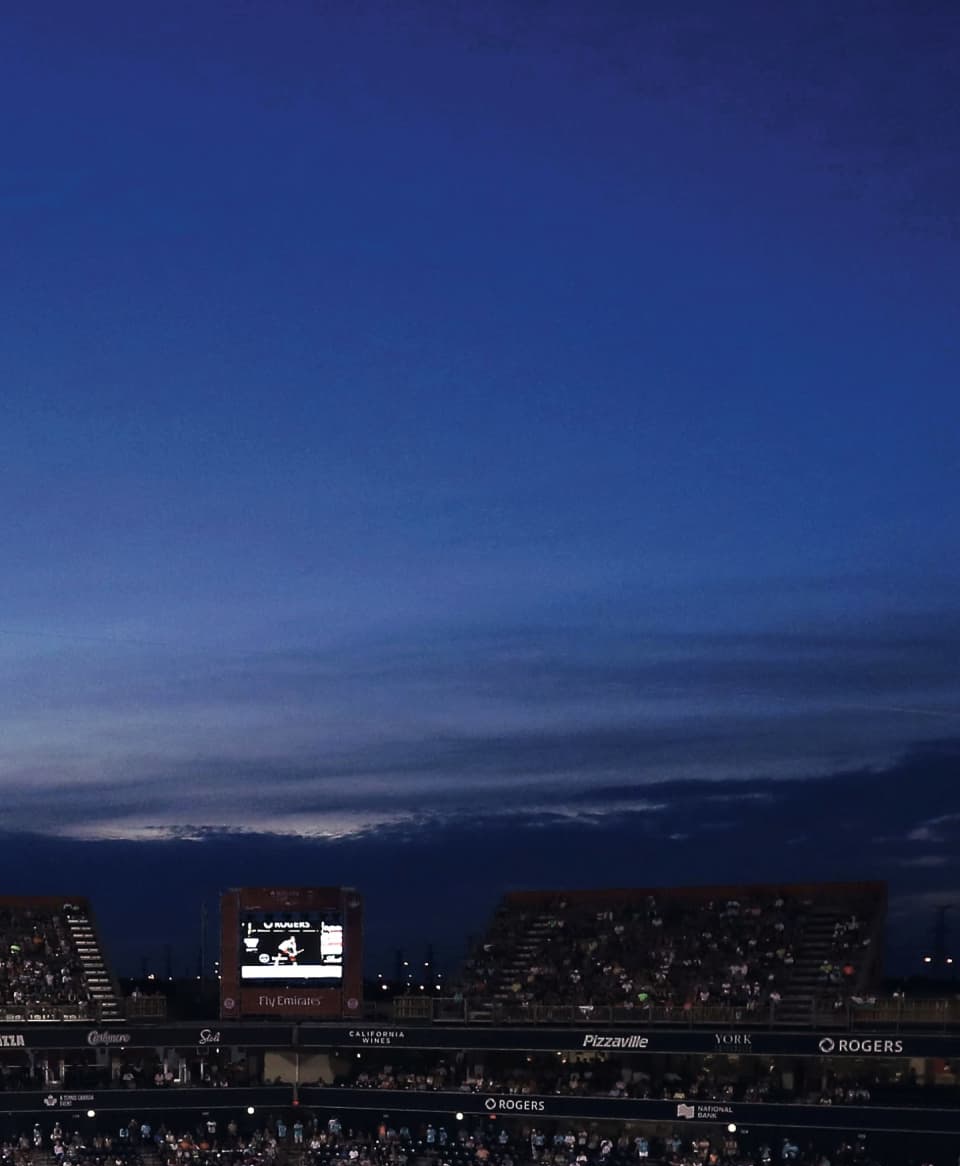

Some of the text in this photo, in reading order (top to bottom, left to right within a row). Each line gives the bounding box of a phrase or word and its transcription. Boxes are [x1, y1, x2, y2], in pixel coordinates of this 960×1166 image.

[259, 996, 321, 1007] Fly Emirates
[582, 1034, 649, 1048] Pizzaville
[715, 1033, 752, 1044] YORK
[839, 1039, 904, 1053] ROGERS
[499, 1099, 545, 1111] ROGERS
[698, 1105, 734, 1113] NATIONAL
